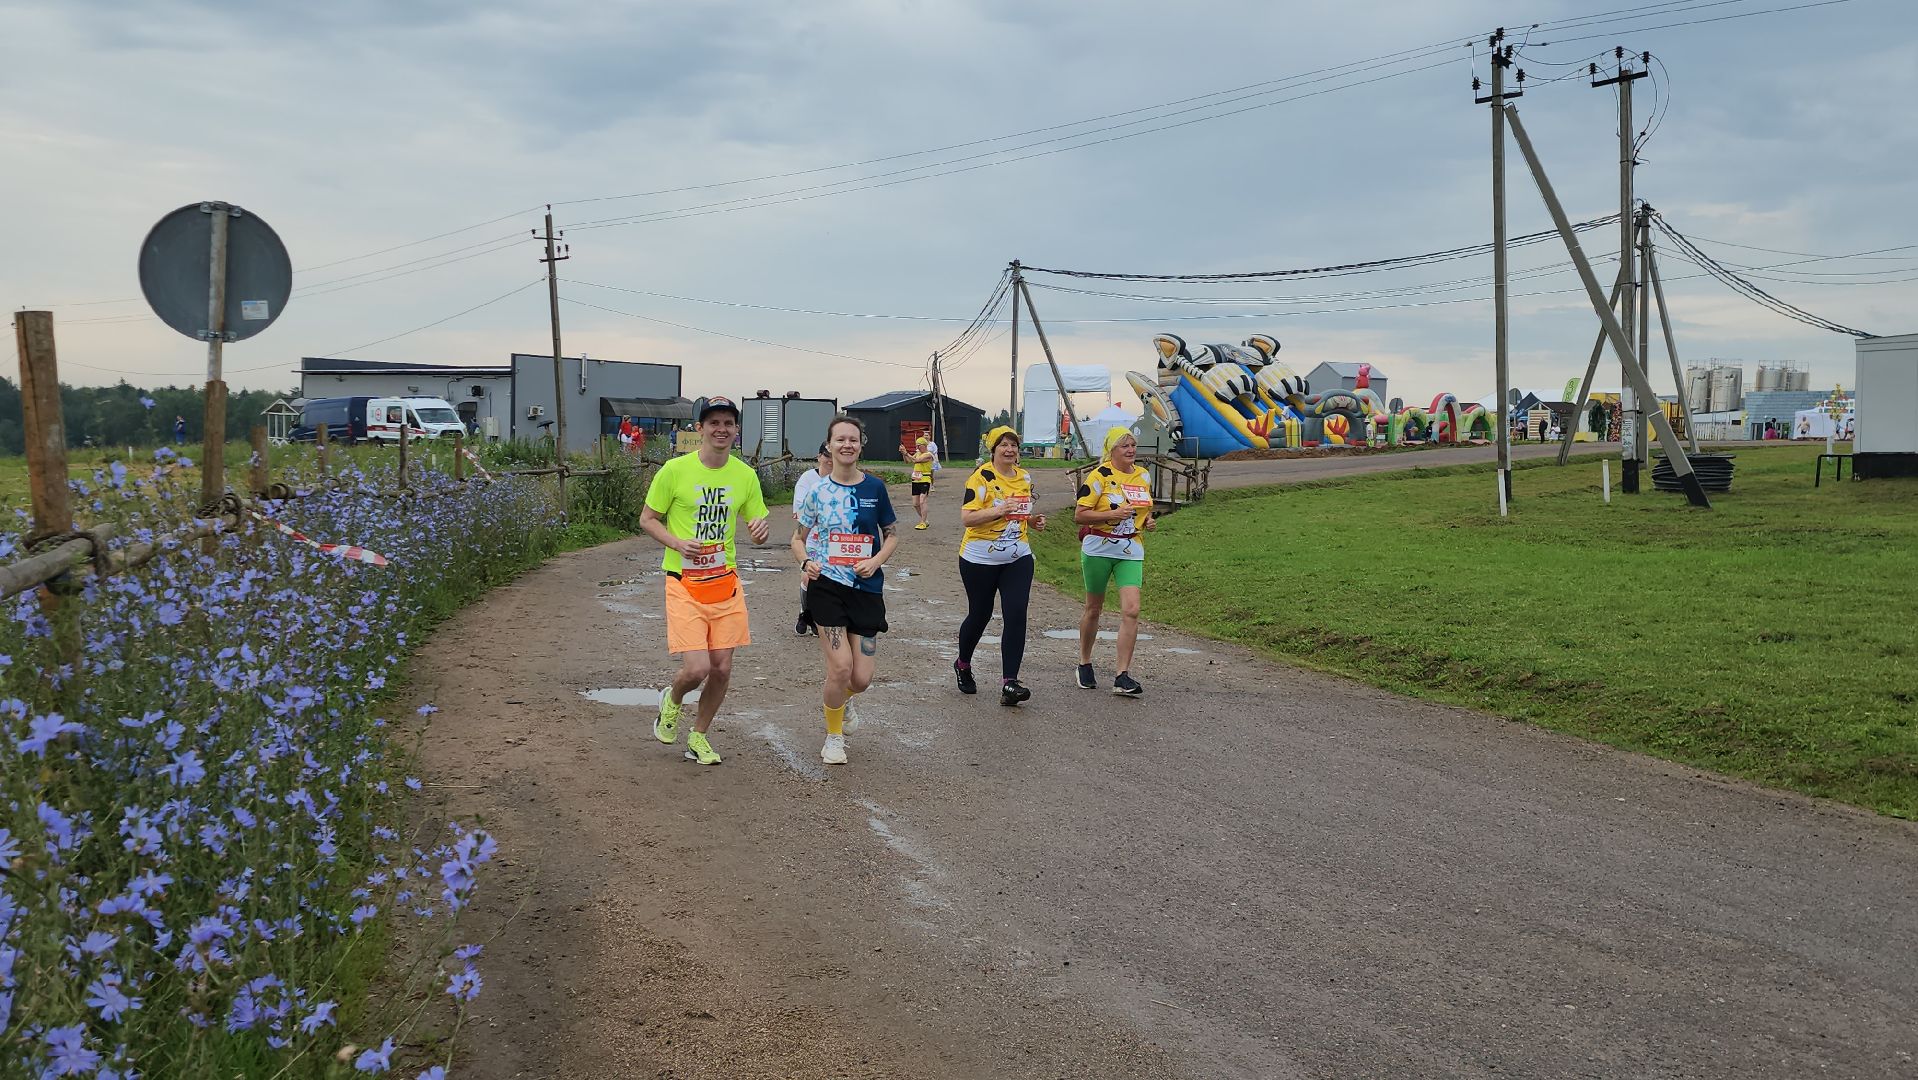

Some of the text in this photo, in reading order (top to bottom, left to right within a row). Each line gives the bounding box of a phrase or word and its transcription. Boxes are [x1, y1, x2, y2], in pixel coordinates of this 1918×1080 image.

[702, 487, 726, 504] WE
[699, 505, 728, 522] RUN
[696, 522, 726, 540] MSK
[840, 543, 862, 553] 586
[693, 555, 716, 566] 504
